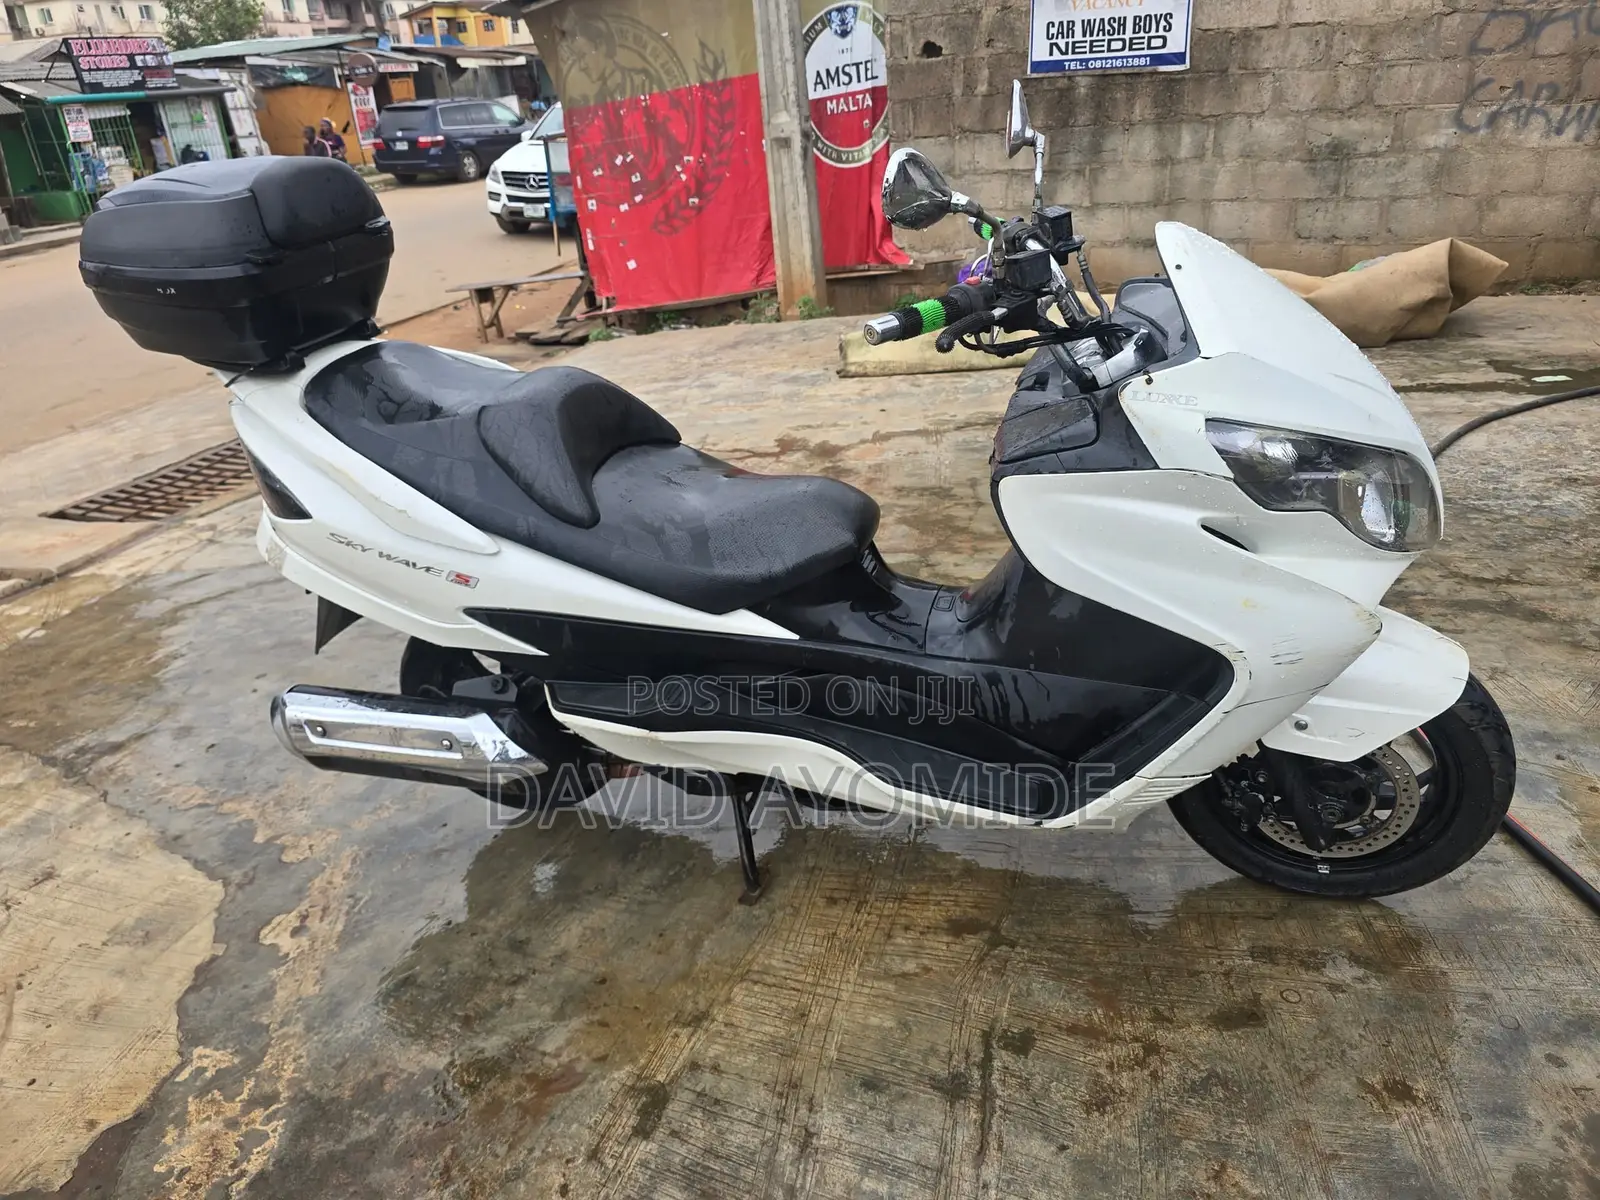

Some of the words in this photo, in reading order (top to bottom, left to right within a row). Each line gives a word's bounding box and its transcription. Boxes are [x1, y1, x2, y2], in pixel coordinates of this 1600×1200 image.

[1046, 20, 1075, 41] CAR
[1081, 16, 1127, 38] WASH
[1132, 12, 1173, 35] BOYS
[1049, 35, 1168, 56] NEEDED
[813, 58, 879, 92] AMSTEL
[1064, 61, 1086, 70] TEL:
[826, 93, 873, 116] MALTA
[817, 139, 838, 159] WITH
[326, 532, 375, 553] SKY
[377, 551, 445, 577] WAVE
